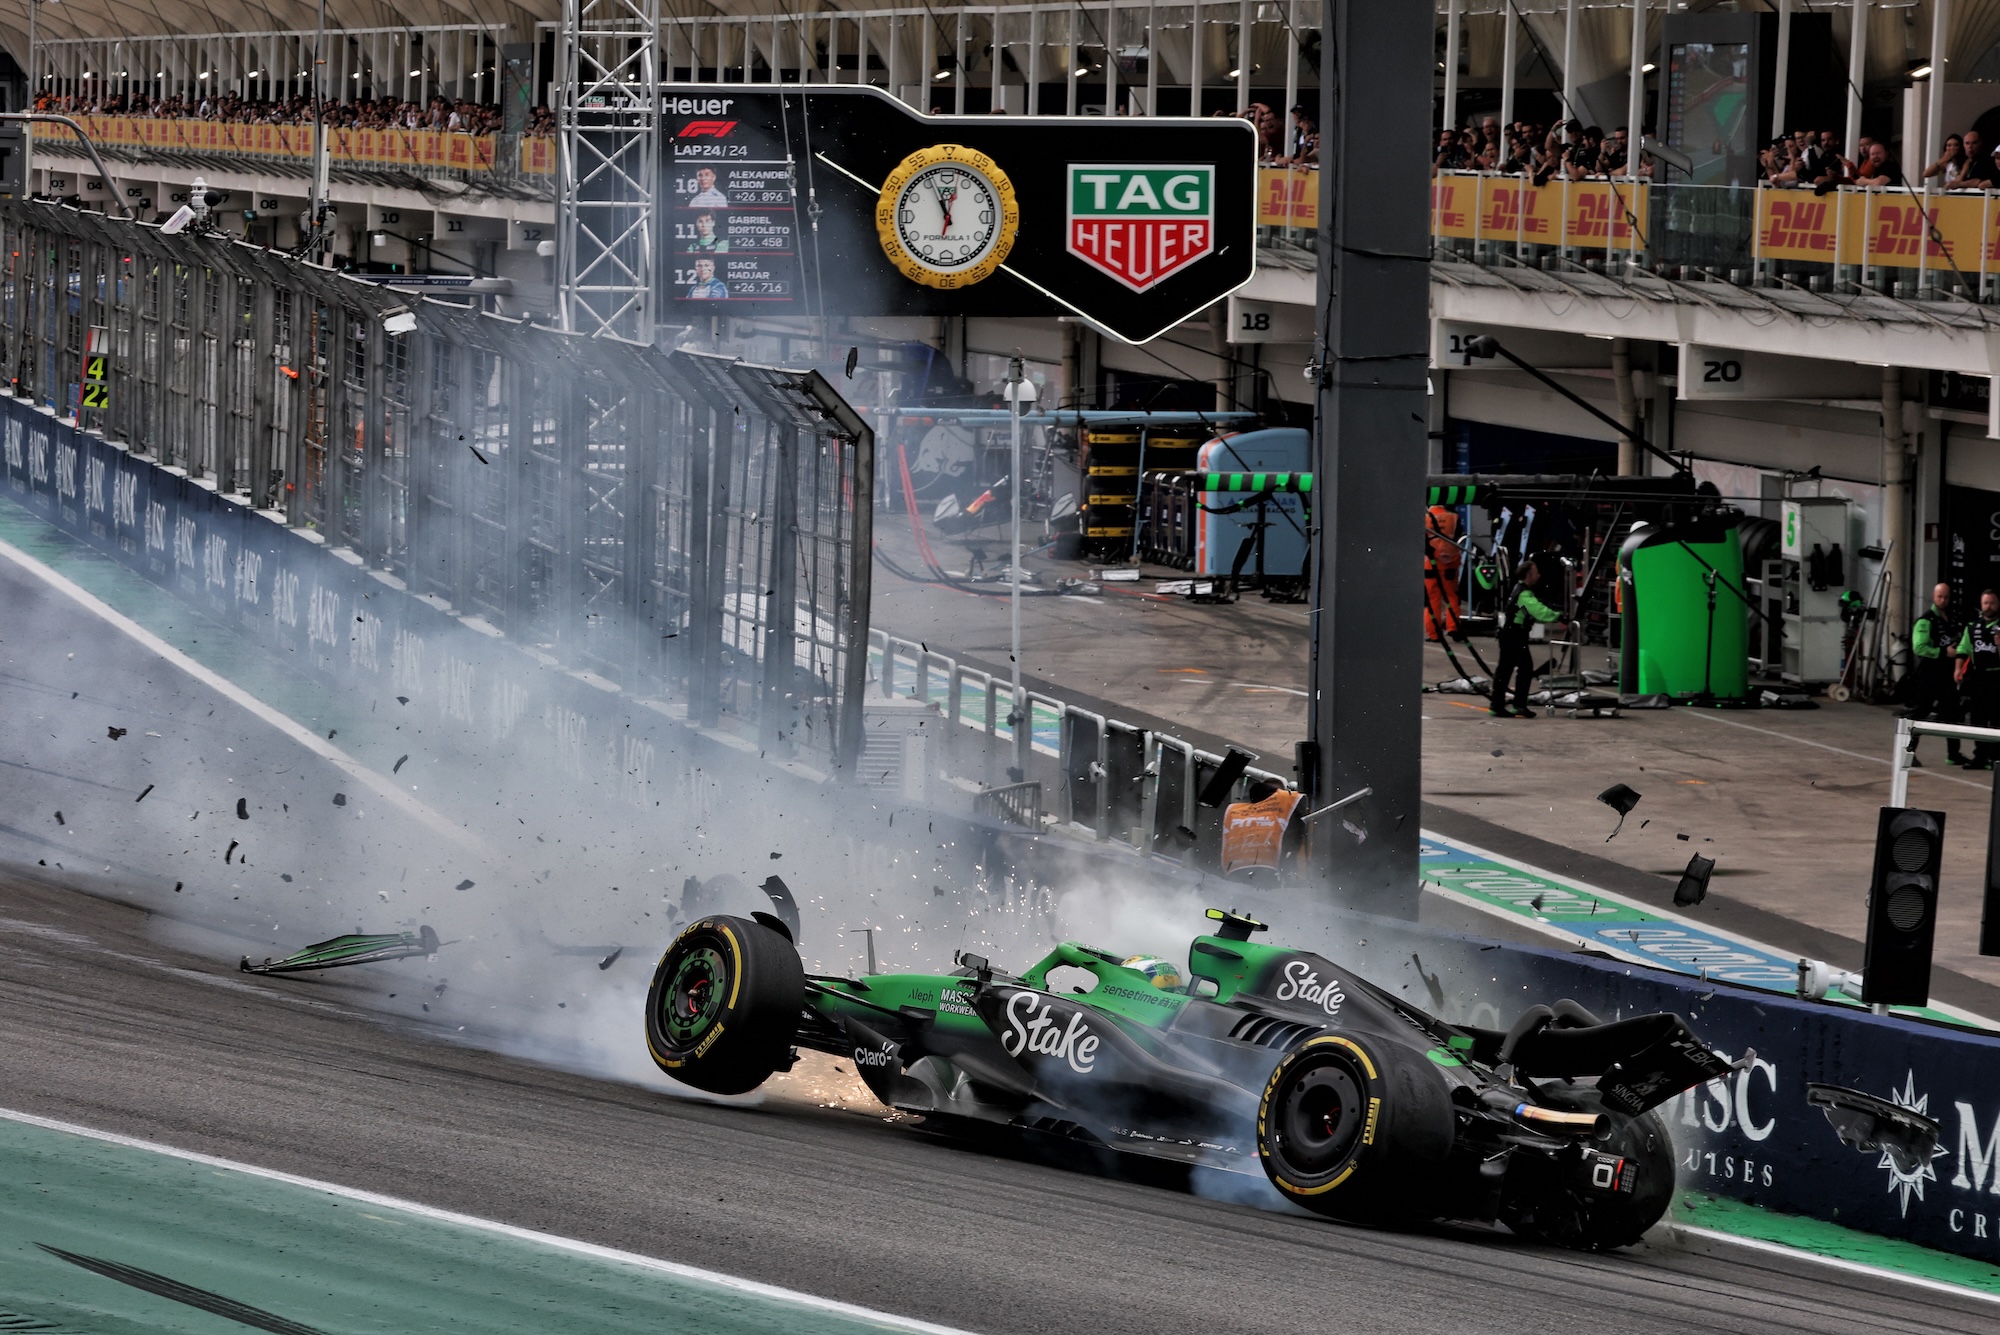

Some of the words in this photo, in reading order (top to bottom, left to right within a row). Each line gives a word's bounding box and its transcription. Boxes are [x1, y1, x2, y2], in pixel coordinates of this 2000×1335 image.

[662, 97, 734, 115] Heuer
[908, 153, 926, 167] 55
[973, 153, 990, 168] 05
[87, 182, 102, 190] 04
[675, 179, 698, 194] 10
[886, 175, 900, 193] 50
[999, 177, 1010, 192] 10
[127, 188, 142, 197] 05
[171, 193, 188, 202] 06
[1080, 175, 1200, 210] TAG
[260, 199, 278, 210] 08
[1492, 189, 1538, 231] DHL
[381, 213, 399, 224] 10
[728, 216, 772, 224] GABRIEL
[879, 208, 889, 225] 45
[1009, 211, 1017, 224] 15
[1576, 194, 1629, 237] DHL
[448, 221, 464, 232] 11
[675, 223, 698, 239] 11
[728, 226, 790, 234] BORTOLETO
[1768, 201, 1828, 249] DHL
[1876, 206, 1941, 257] DHL
[523, 229, 541, 240] 12
[734, 237, 783, 247] +26.450
[885, 241, 898, 258] 40
[997, 241, 1011, 259] 20
[1077, 224, 1204, 281] HEUER
[727, 261, 758, 269] ISACK
[674, 269, 698, 285] 12
[727, 271, 770, 280] HADJAR
[907, 267, 925, 281] 35
[972, 267, 988, 281] 25
[734, 282, 783, 292] +26.716
[939, 278, 956, 287] 30
[1242, 312, 1270, 331] 18
[88, 357, 104, 380] 4
[1704, 360, 1742, 382] 20
[1786, 512, 1795, 547] 5
[908, 988, 933, 1003] Aleph
[1102, 984, 1159, 1005] sensetime
[1276, 961, 1345, 1015] Stake
[1001, 991, 1100, 1073] Stake
[855, 1046, 888, 1067] Claro
[1259, 1066, 1281, 1137] ZERO
[1611, 1083, 1645, 1112] SINGHA
